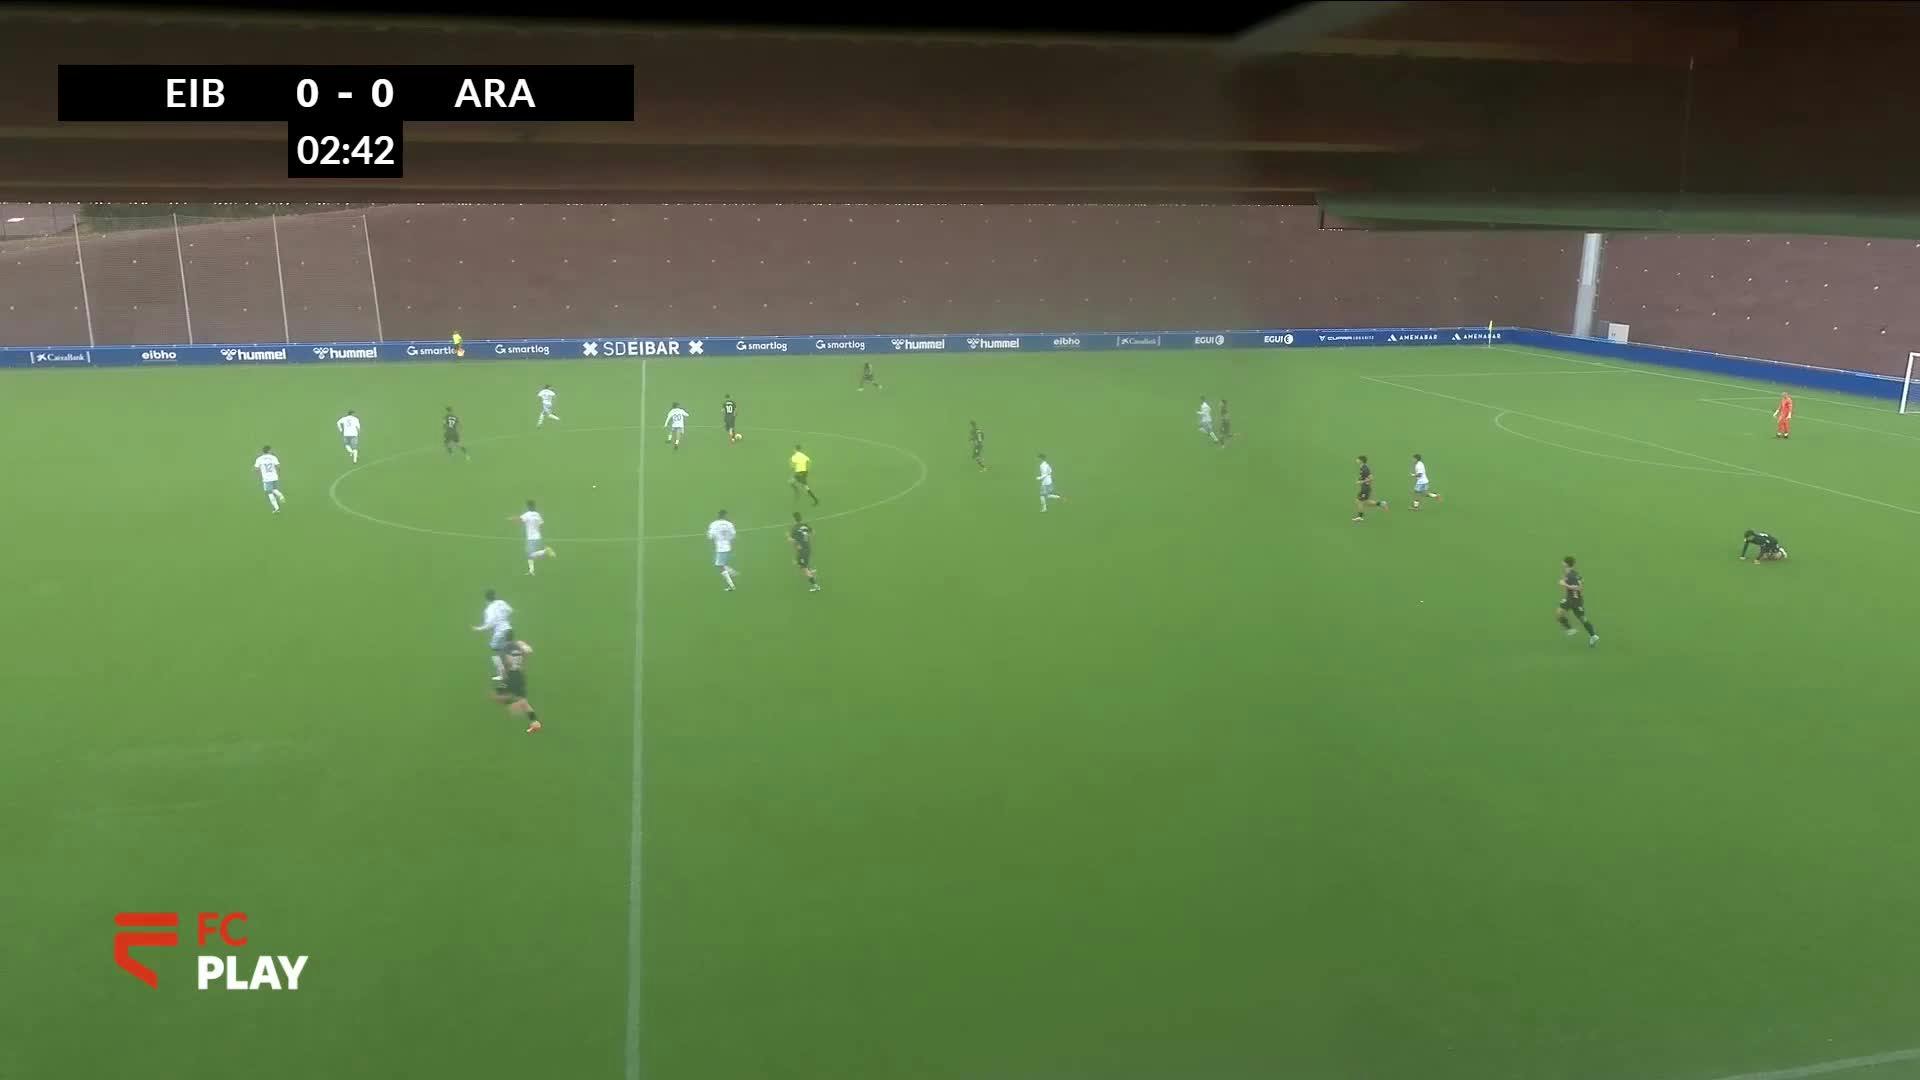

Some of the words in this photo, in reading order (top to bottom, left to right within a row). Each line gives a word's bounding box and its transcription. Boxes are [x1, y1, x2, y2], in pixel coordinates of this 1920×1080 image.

[827, 339, 866, 350] smartlog
[905, 338, 946, 350] hummel
[980, 337, 1020, 349] hummel
[1053, 337, 1081, 346] eibho
[1194, 336, 1215, 345] EGUI
[1263, 335, 1284, 344] EGUI
[420, 346, 459, 355] smartlo
[508, 344, 550, 355] smartlog
[748, 341, 788, 351] smartlog
[141, 350, 177, 360] eibho
[238, 348, 287, 361] hummel
[329, 346, 378, 360] hummel
[725, 404, 733, 414] 10
